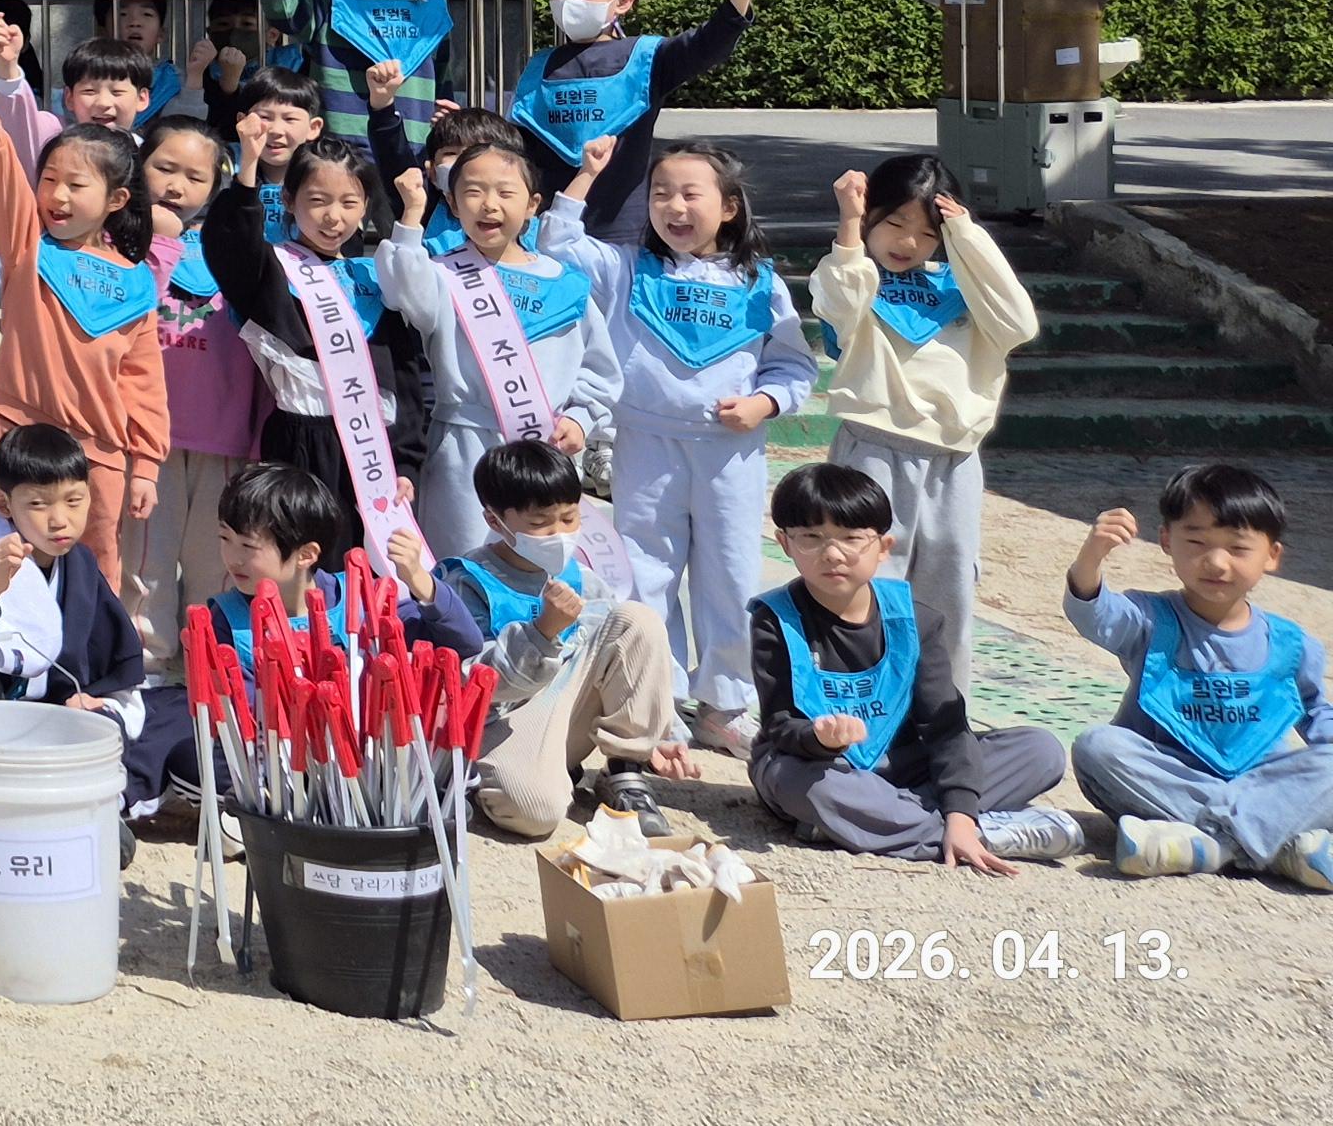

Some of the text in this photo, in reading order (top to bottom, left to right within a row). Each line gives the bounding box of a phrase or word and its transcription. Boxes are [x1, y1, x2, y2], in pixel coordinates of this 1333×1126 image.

[368, 23, 419, 40] 배려해요
[555, 89, 597, 106] 팀원을
[548, 106, 605, 124] 배려해요
[675, 285, 728, 307] 팀원을
[664, 307, 733, 329] 배려해요
[298, 264, 383, 482] 오늘의 주인공
[820, 678, 874, 699] 팀원을
[1191, 678, 1251, 700] 팀원을
[1179, 701, 1261, 725] 배려해요
[9, 853, 54, 878] 유리
[312, 871, 341, 888] 쓰담
